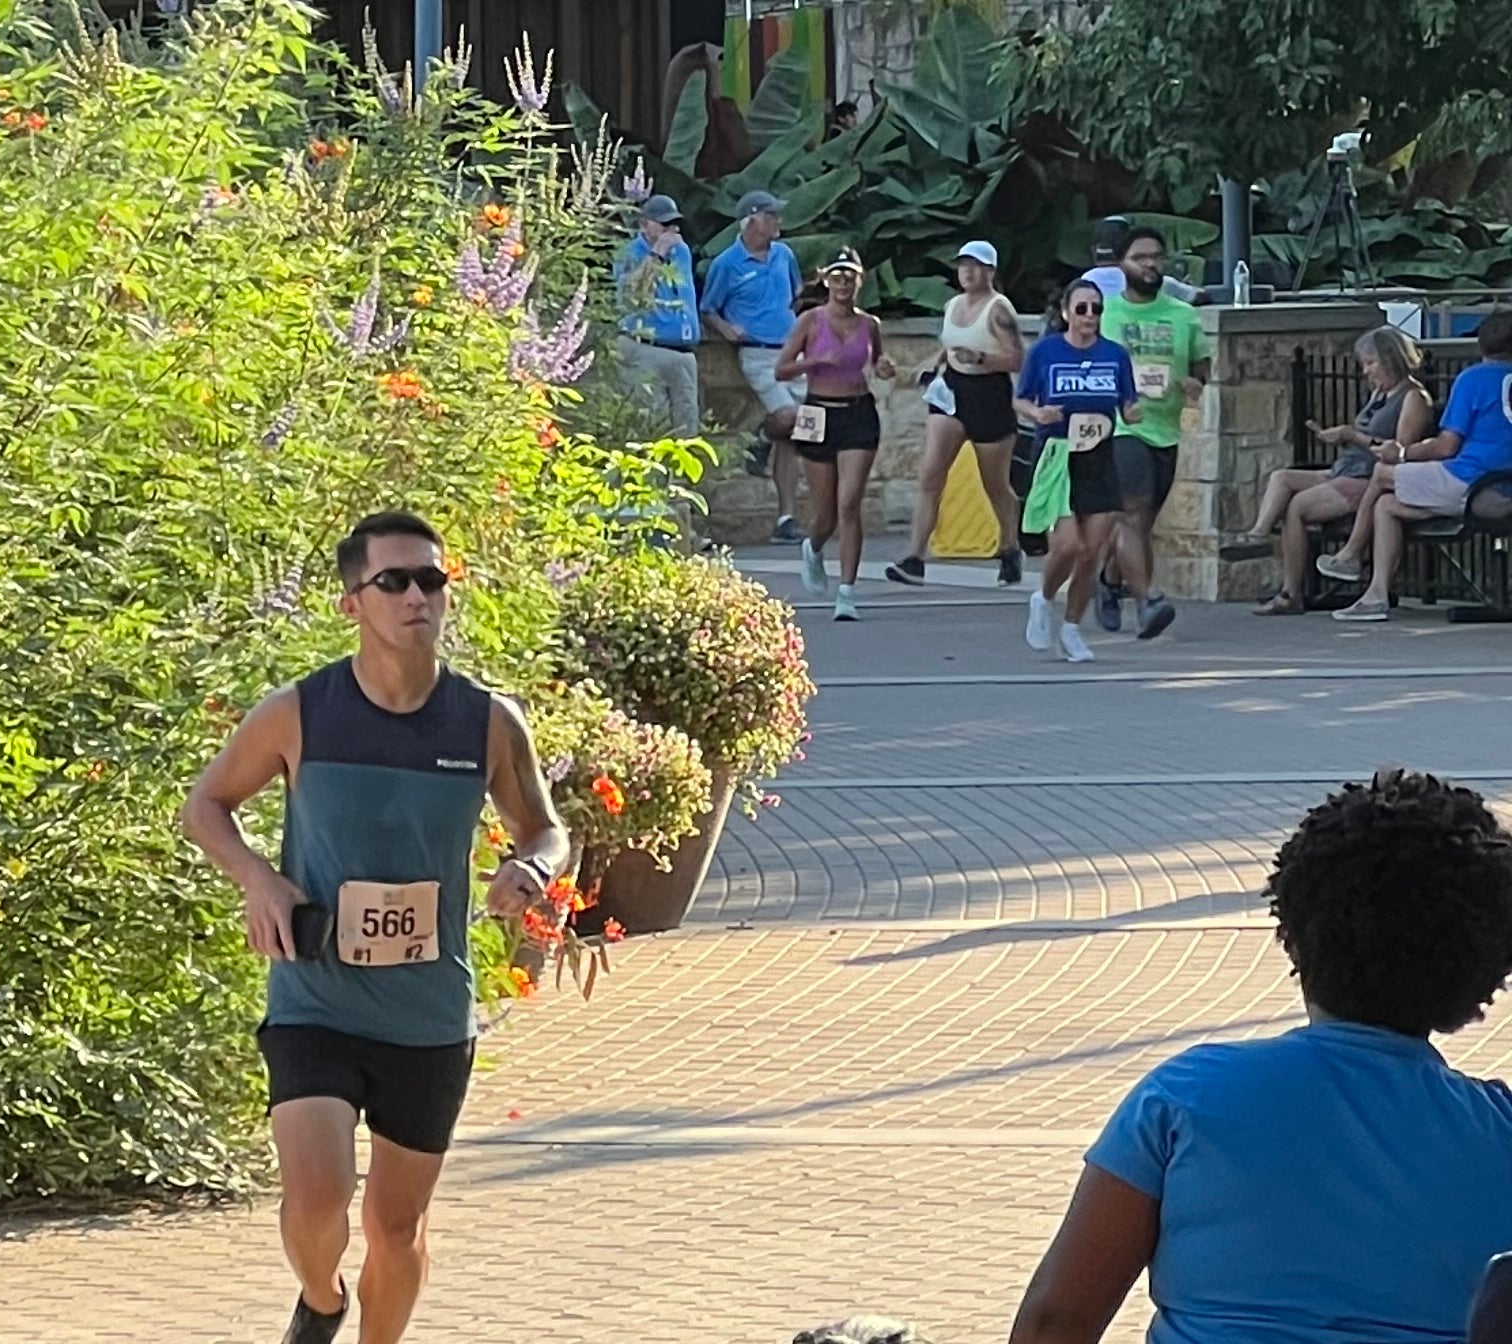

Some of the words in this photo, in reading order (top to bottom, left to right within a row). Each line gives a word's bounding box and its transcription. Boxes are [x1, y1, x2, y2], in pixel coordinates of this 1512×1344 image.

[1056, 376, 1116, 391] FITNESS
[1079, 424, 1102, 438] 561
[361, 906, 415, 938] 566
[353, 947, 371, 964] #1
[404, 943, 424, 960] #2
